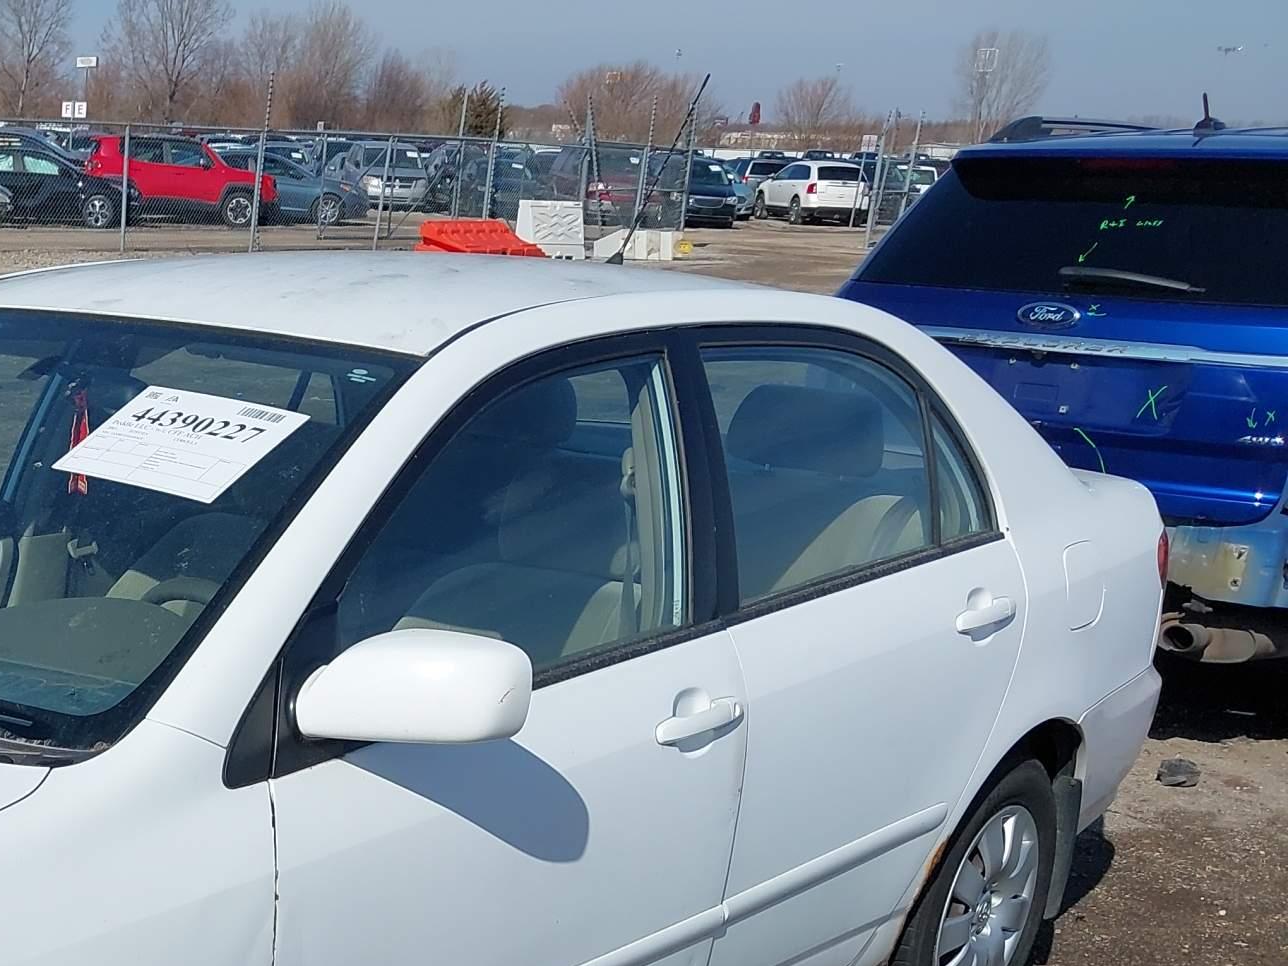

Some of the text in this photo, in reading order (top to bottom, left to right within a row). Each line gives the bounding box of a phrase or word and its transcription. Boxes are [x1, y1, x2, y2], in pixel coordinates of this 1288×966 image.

[65, 104, 71, 114] F
[77, 104, 84, 115] E
[1029, 305, 1066, 321] Ford
[130, 406, 267, 444] 44390227
